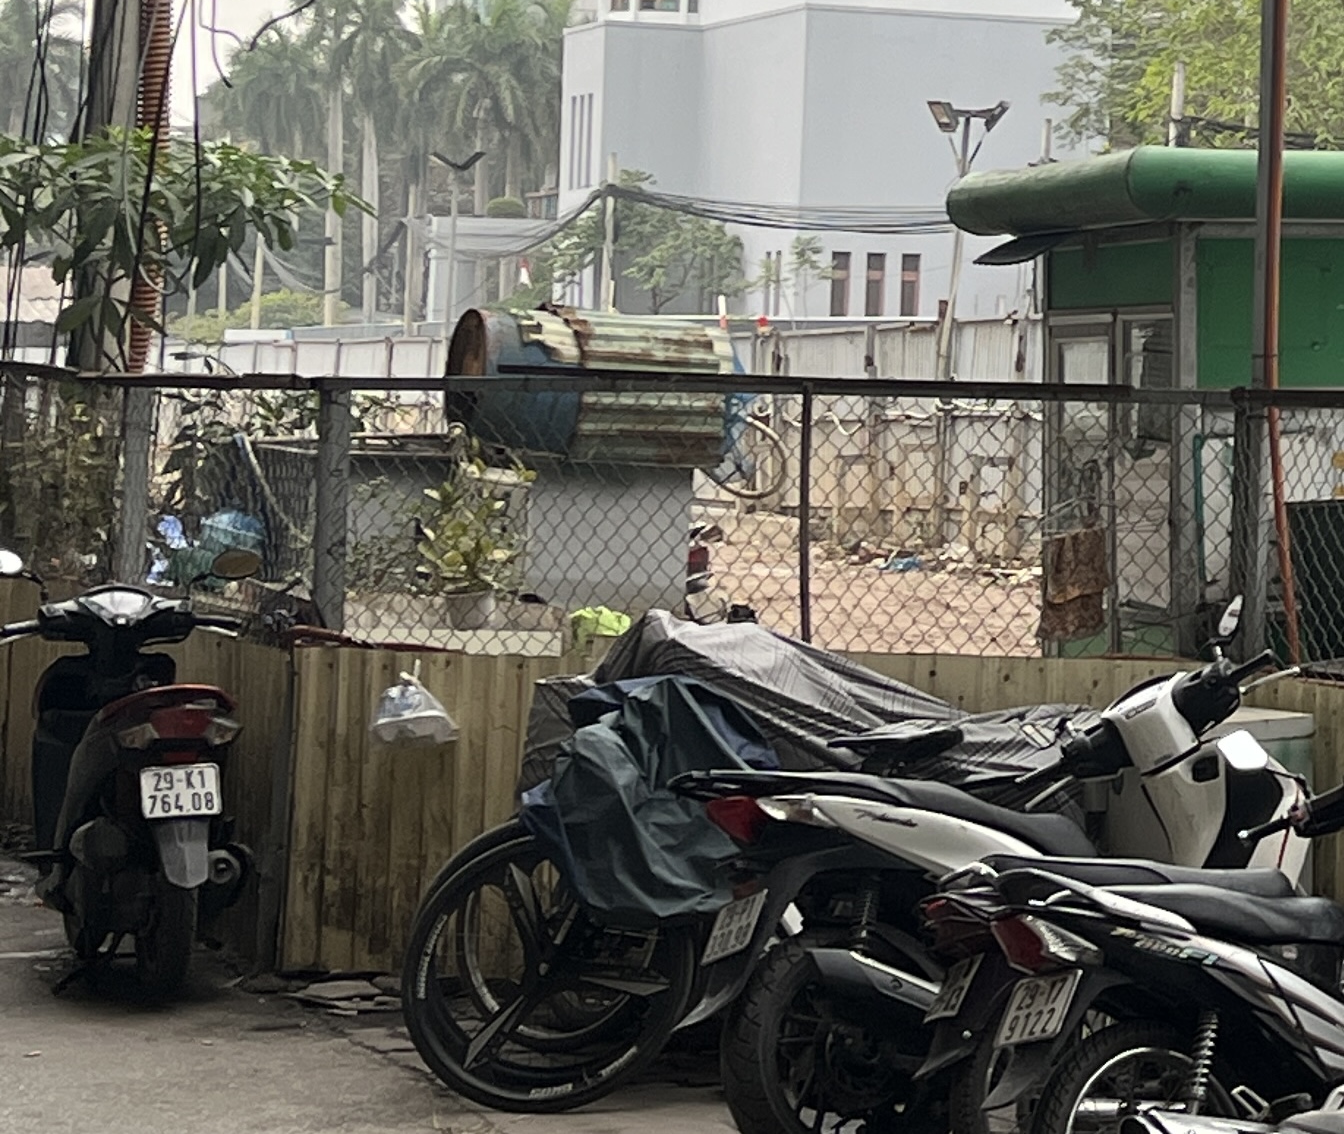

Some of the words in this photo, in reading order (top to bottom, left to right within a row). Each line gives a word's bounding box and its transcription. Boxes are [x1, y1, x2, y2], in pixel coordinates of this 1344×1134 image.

[152, 770, 206, 792] 29-K1
[148, 791, 215, 815] 764.08
[1005, 1006, 1056, 1041] 9122
